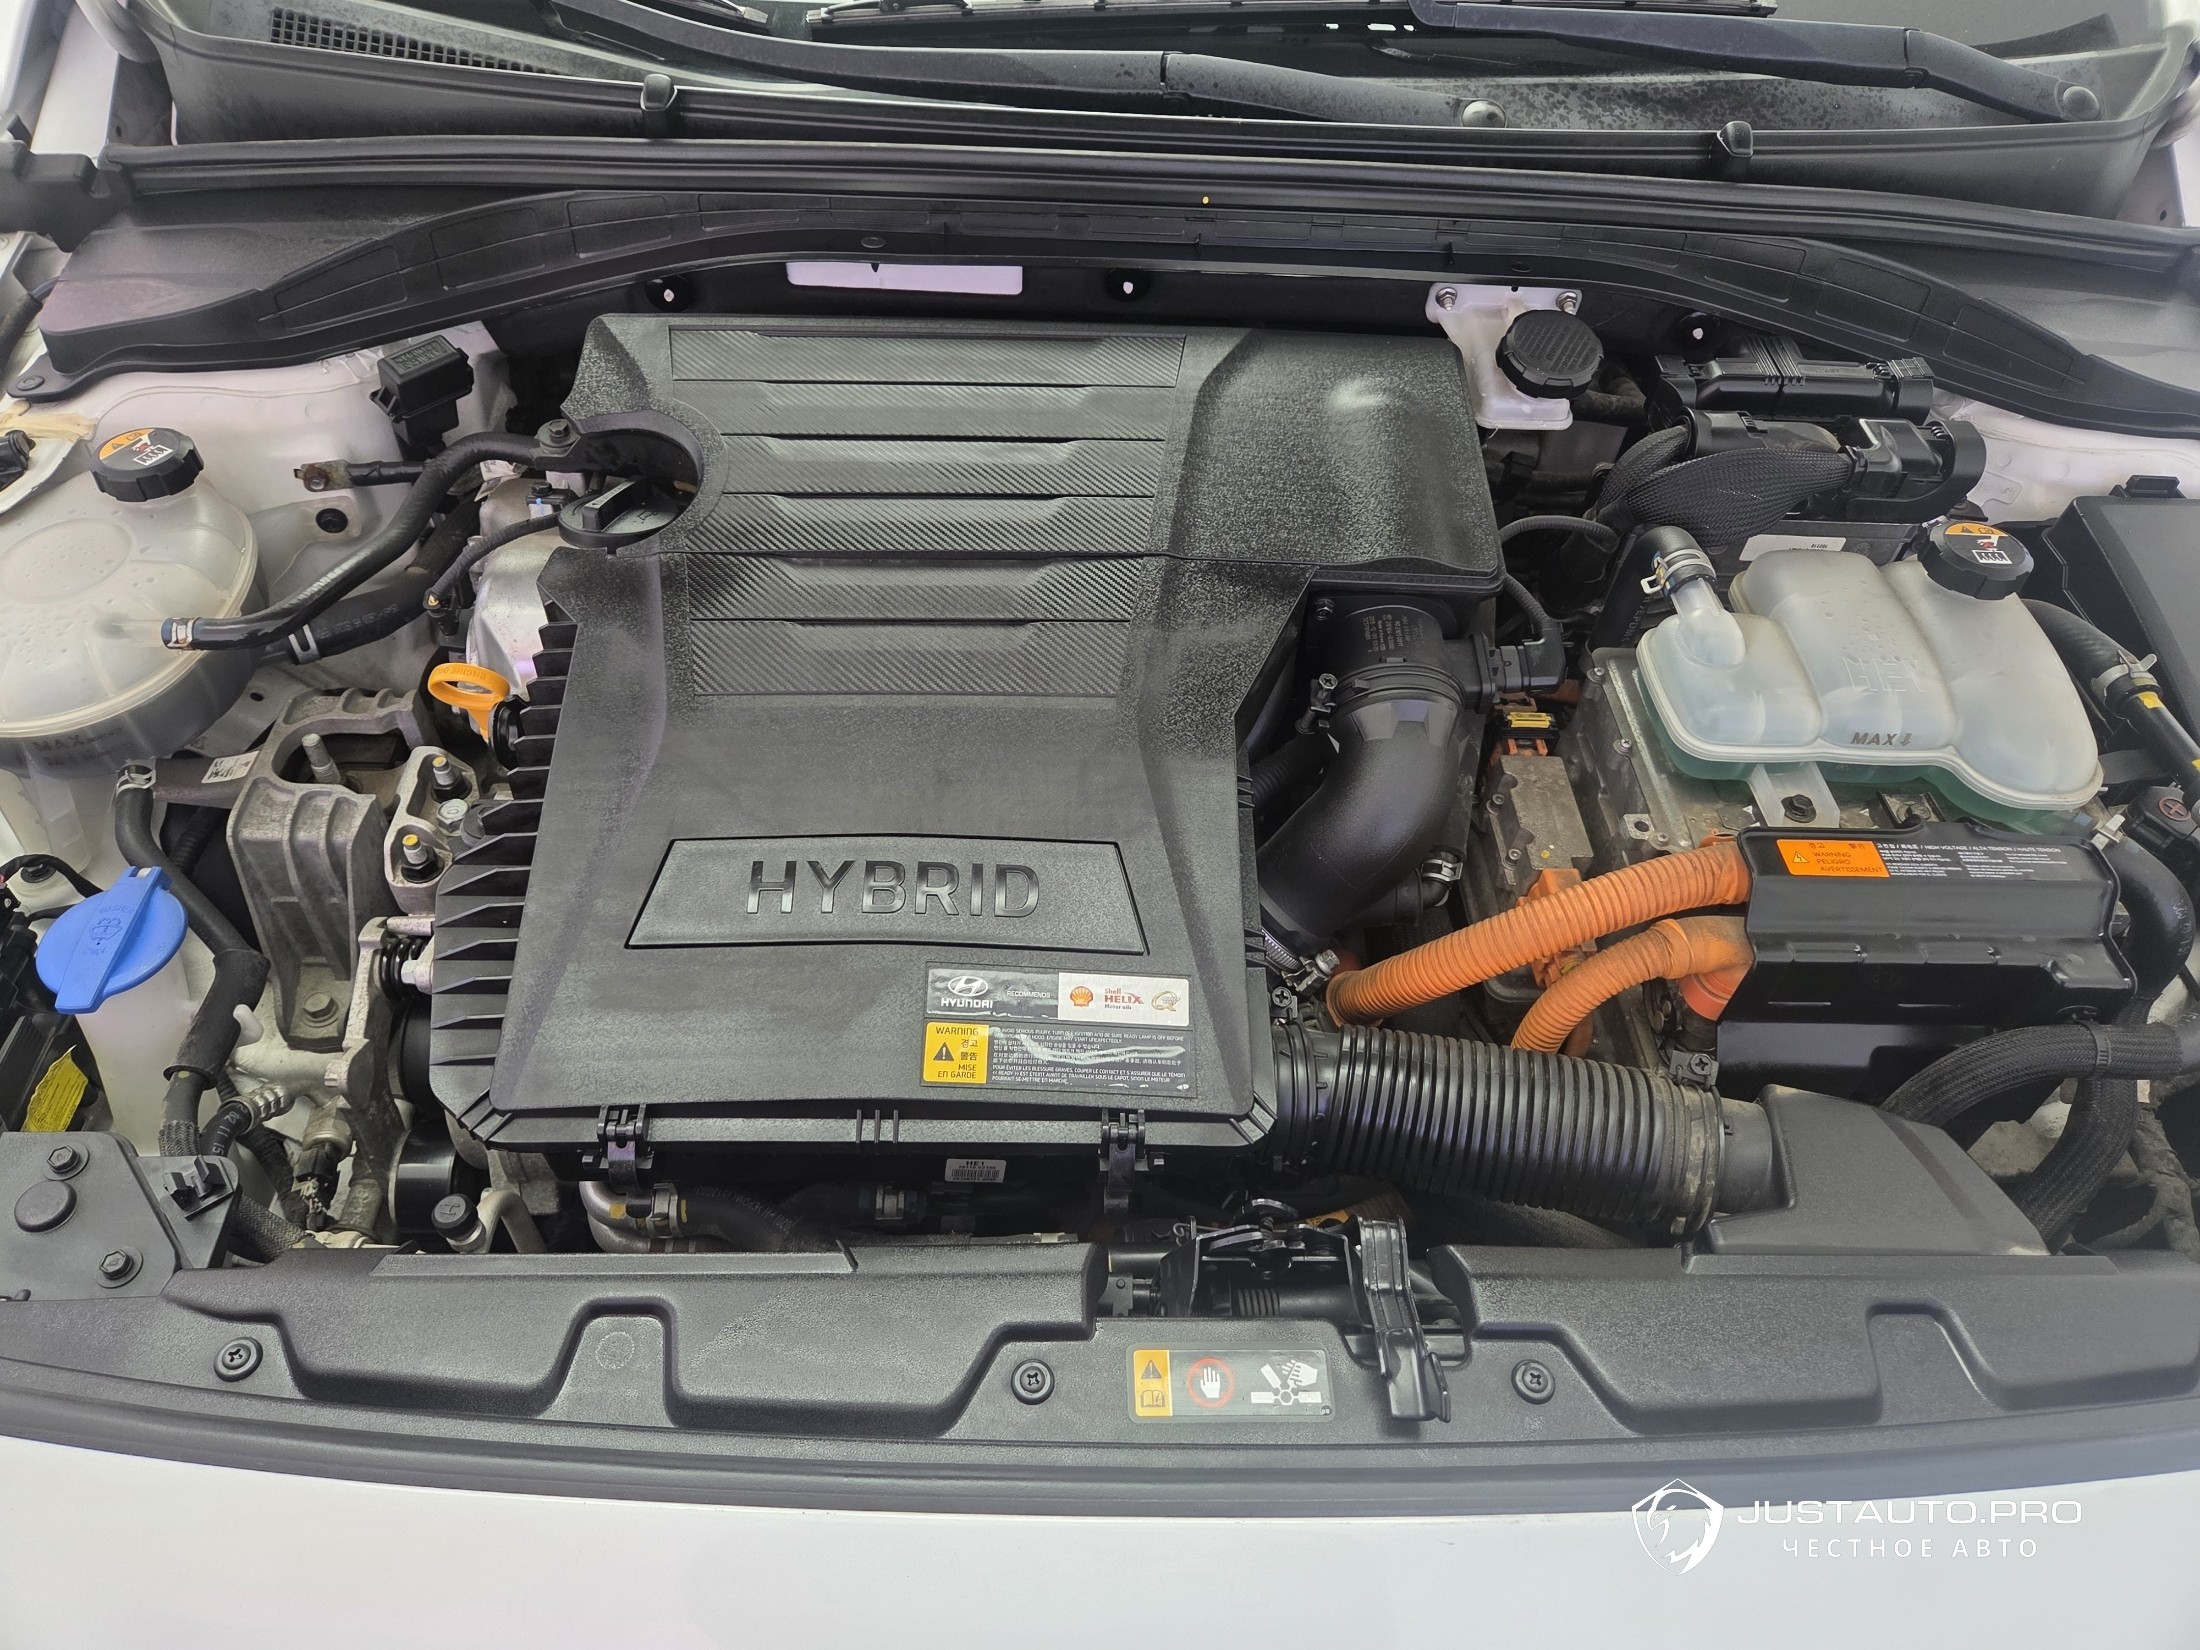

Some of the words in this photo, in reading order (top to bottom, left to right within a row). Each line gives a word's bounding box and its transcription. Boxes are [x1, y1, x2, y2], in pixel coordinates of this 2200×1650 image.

[1850, 731, 1899, 746] MAX
[746, 860, 1040, 918] HYBRID
[1006, 990, 1052, 999] RECOMMENDS
[1104, 993, 1144, 1005] HELIX
[941, 997, 994, 1009] HYUNDAI
[935, 1026, 979, 1036] WARNING
[961, 1039, 979, 1048] 경고
[960, 1051, 978, 1061] 警告
[958, 1063, 977, 1071] MISE
[937, 1070, 948, 1078] EN
[950, 1070, 977, 1079] GARDE
[212, 1142, 225, 1156] 15
